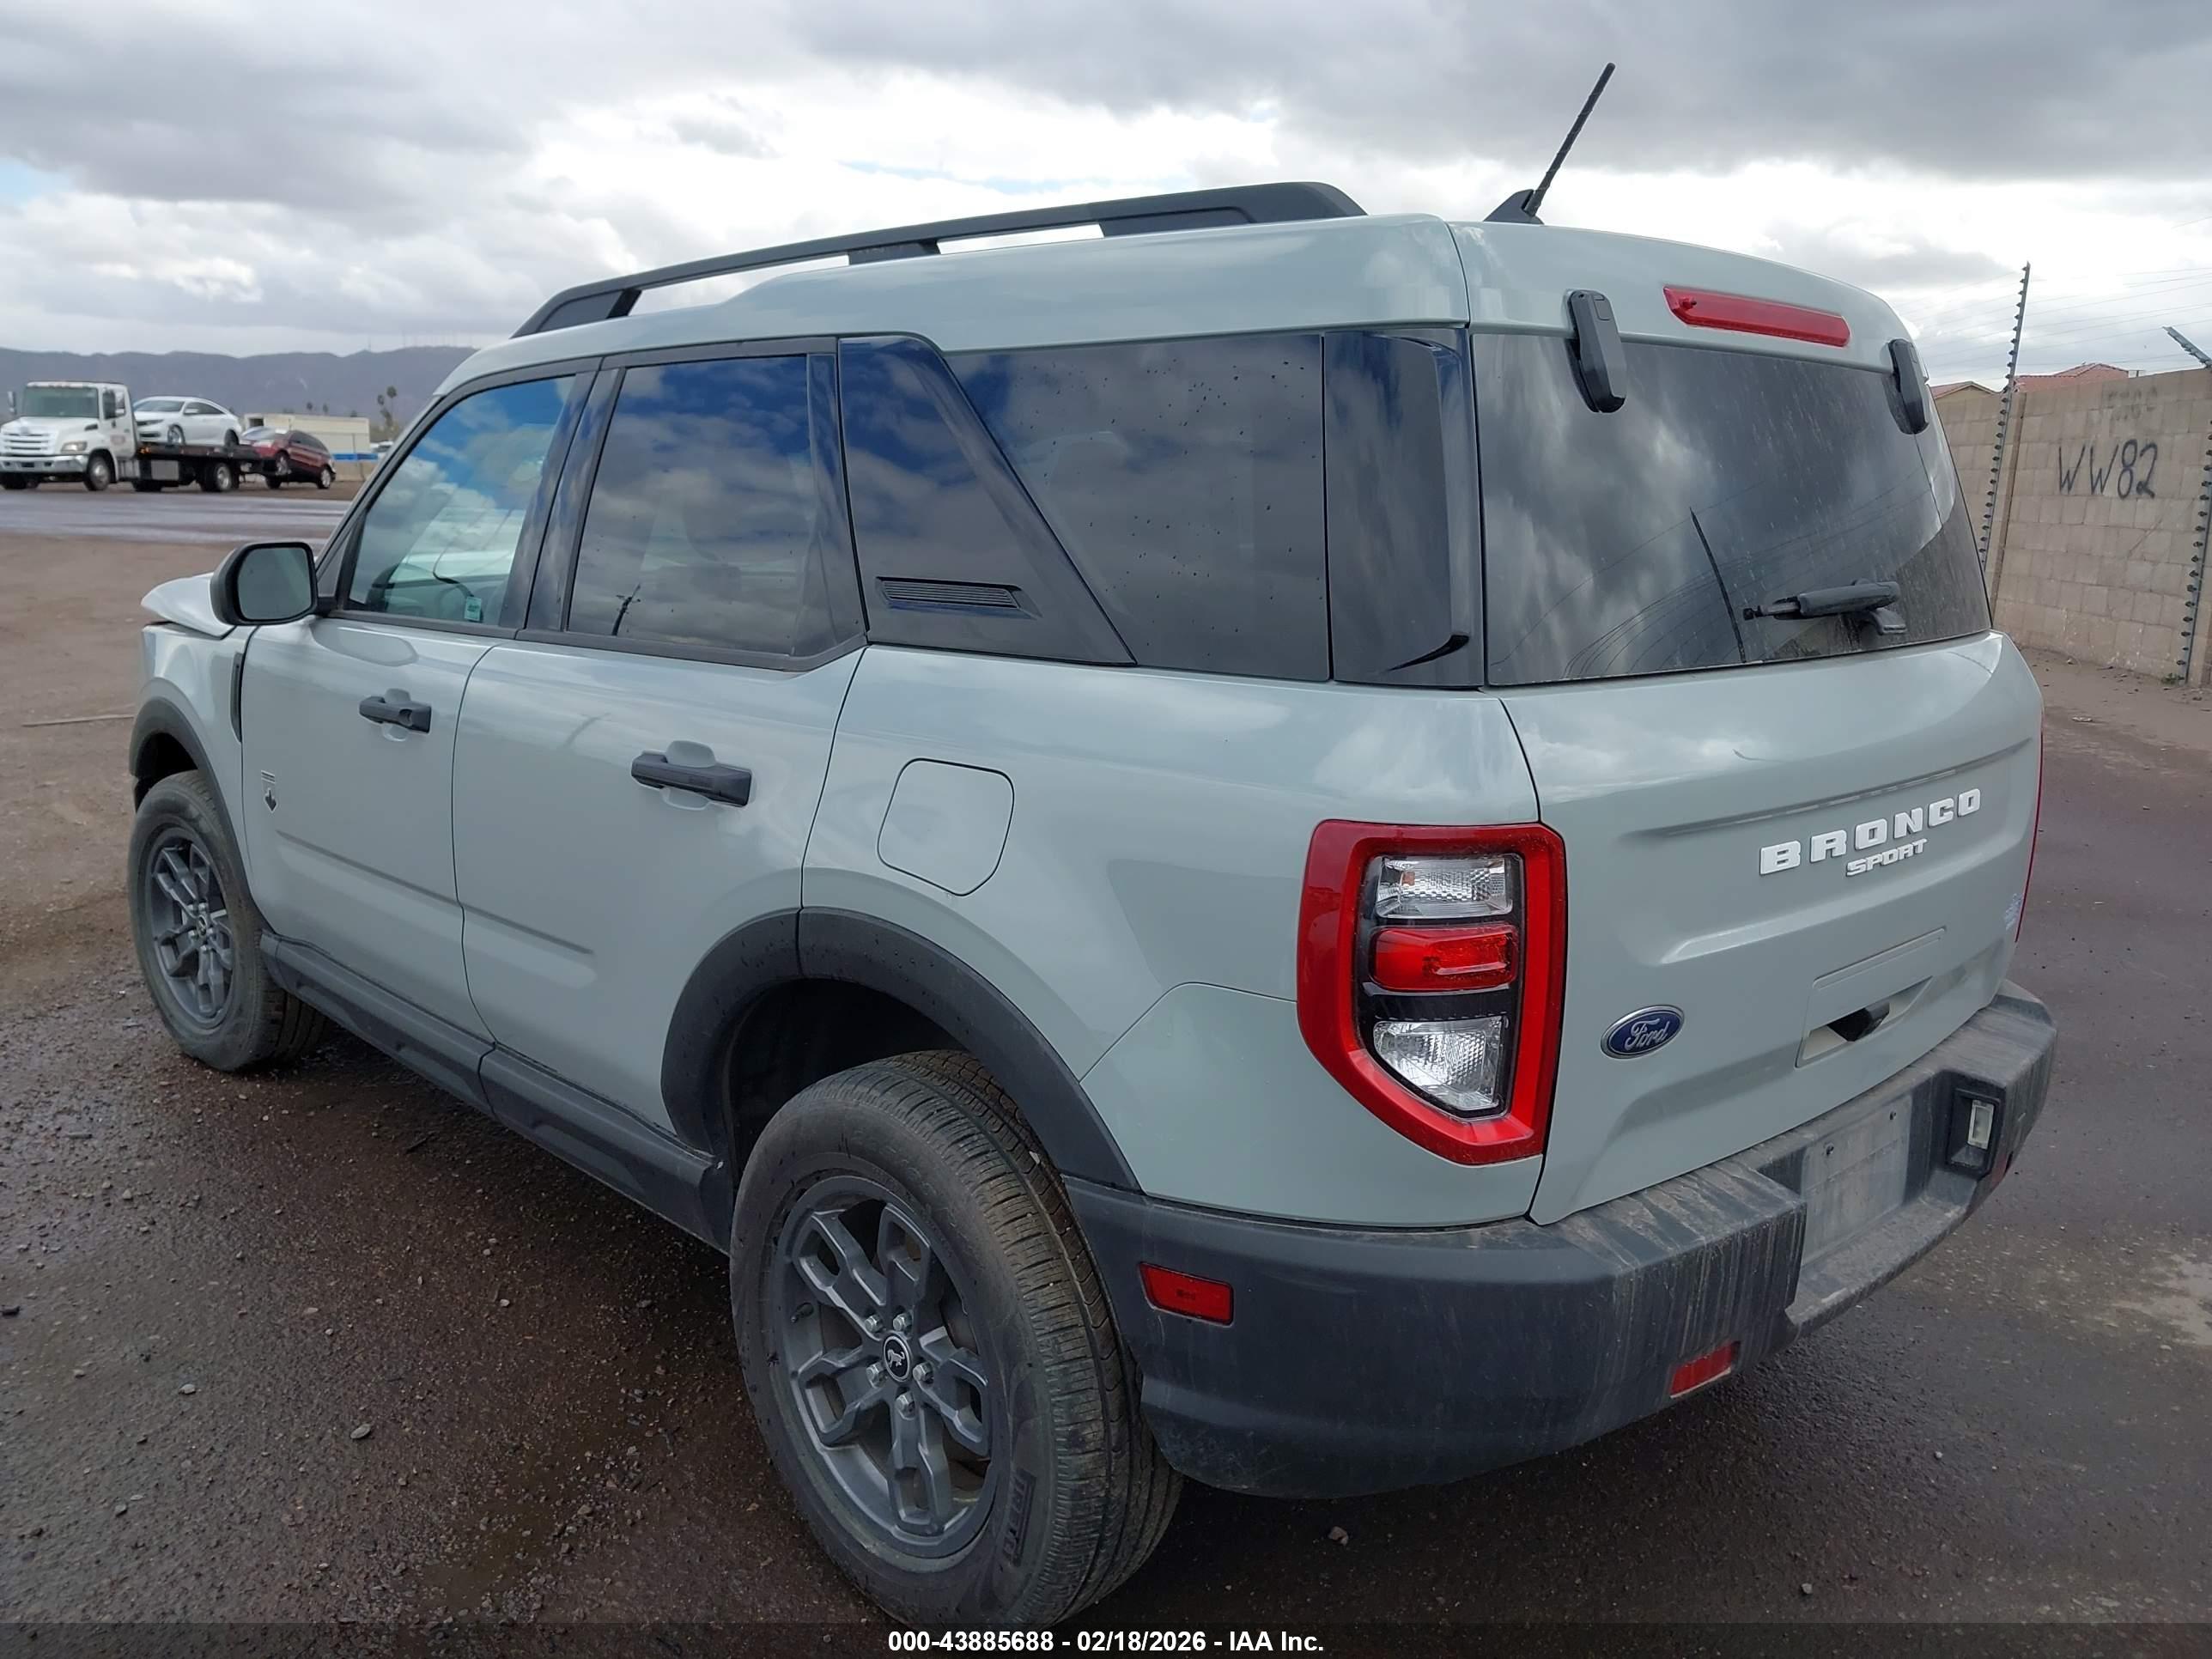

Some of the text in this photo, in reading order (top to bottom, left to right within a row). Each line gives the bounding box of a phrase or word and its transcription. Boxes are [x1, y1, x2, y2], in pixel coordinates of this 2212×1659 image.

[2058, 439, 2158, 500] WW82
[1759, 788, 1980, 875] BRONCO
[1846, 838, 1928, 876] SPORT
[1624, 1018, 1670, 1051] Ford
